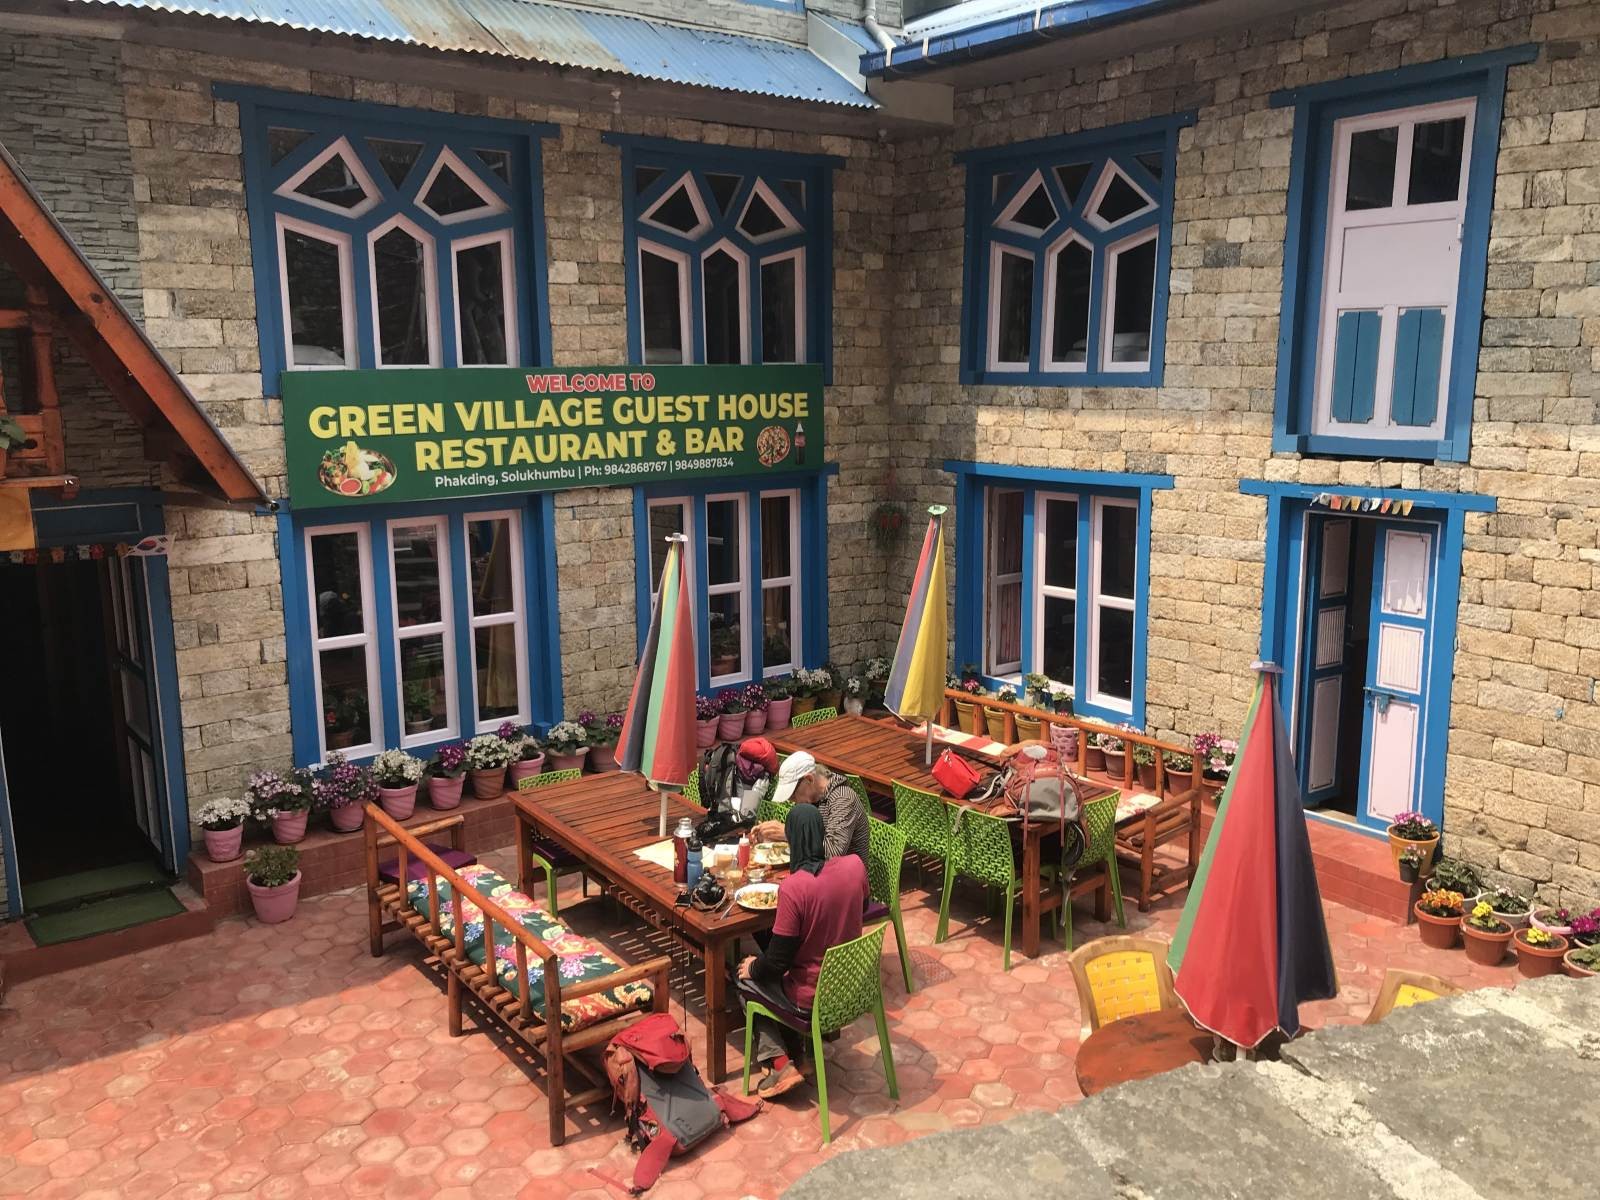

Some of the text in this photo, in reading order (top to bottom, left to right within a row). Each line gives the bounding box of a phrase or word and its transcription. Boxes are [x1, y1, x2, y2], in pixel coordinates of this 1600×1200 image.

[526, 373, 656, 394] WELCOME TO
[308, 392, 808, 439] GREEN VILLAGE GUEST HOUSE
[415, 426, 744, 471] RESTAURANT & BAR
[435, 472, 499, 488] Phakding,
[501, 467, 575, 483] Solukhumbu
[584, 465, 602, 477] Ph:
[604, 461, 667, 475] 9842868767
[675, 457, 734, 471] 9849887834
